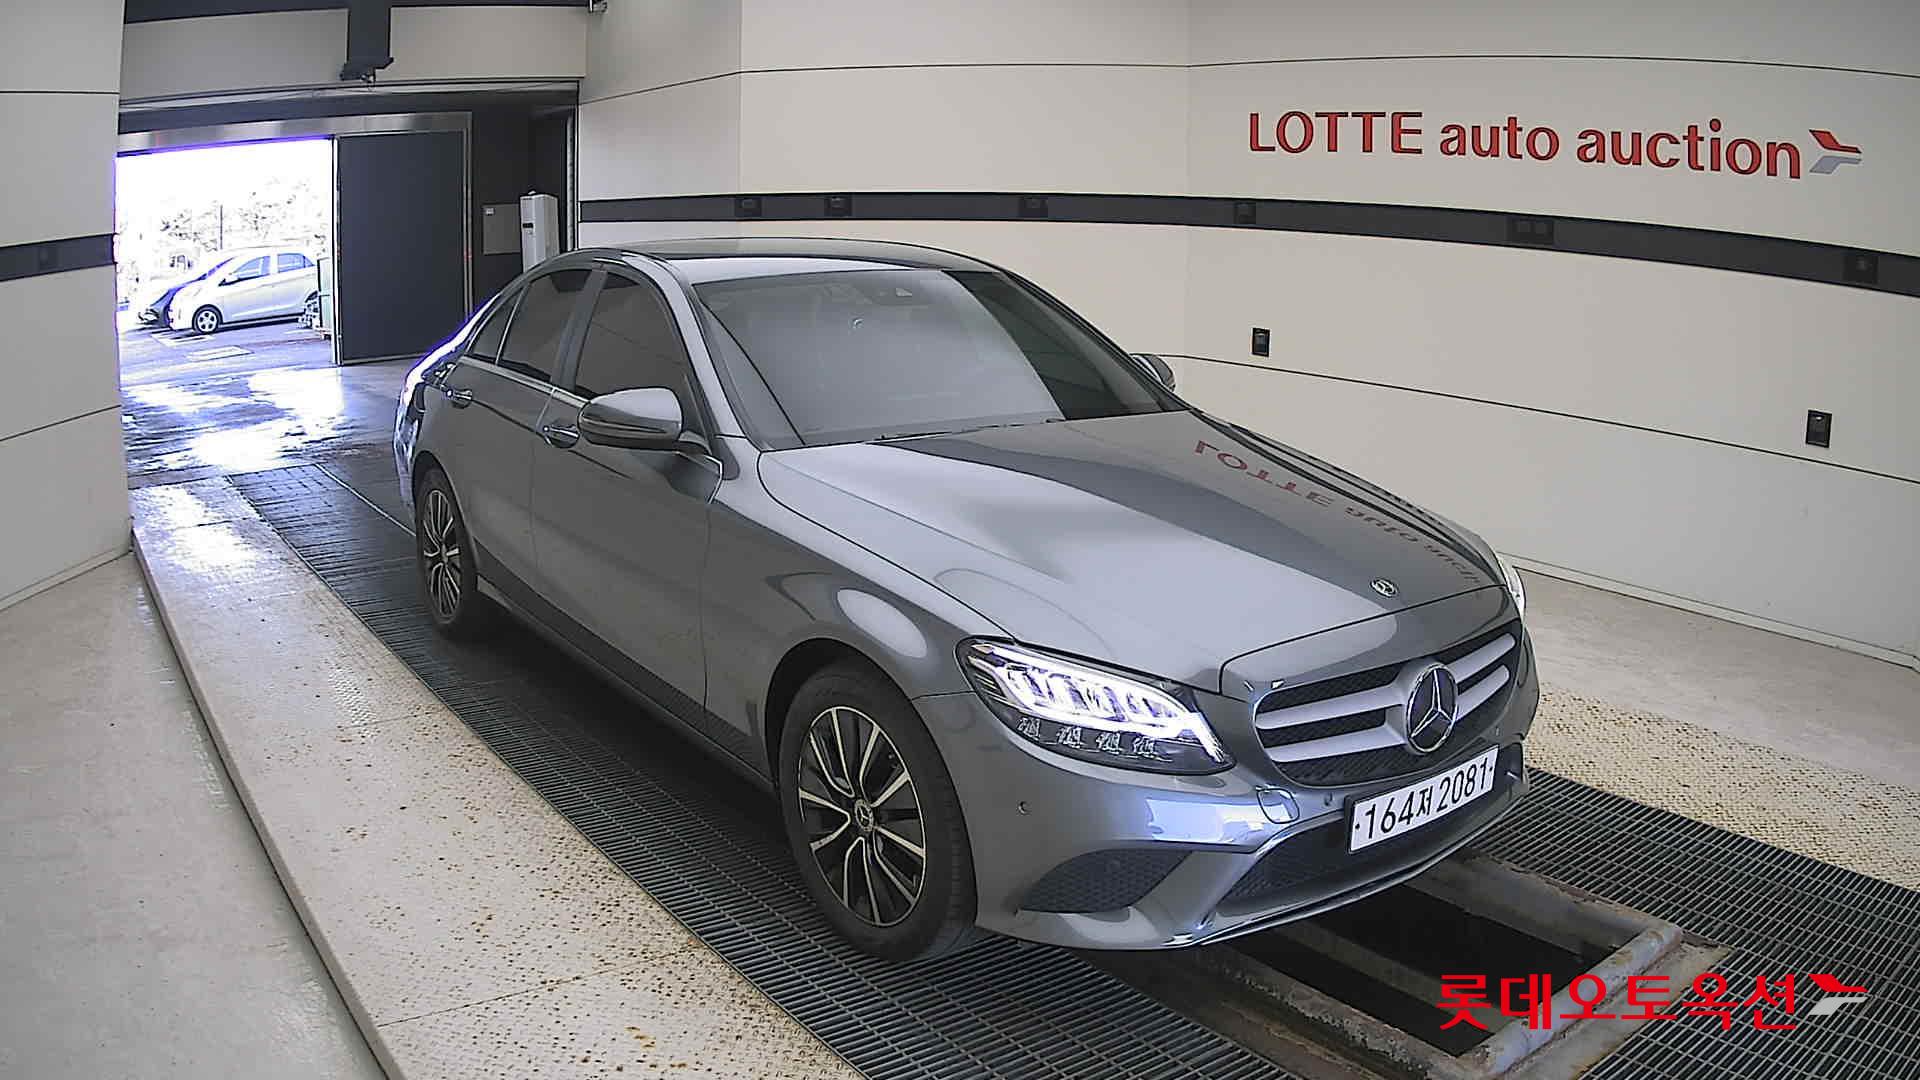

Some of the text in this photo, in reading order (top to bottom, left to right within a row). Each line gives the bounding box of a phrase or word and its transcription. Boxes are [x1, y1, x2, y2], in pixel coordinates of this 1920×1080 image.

[1249, 111, 1801, 178] LOTTE auto auction
